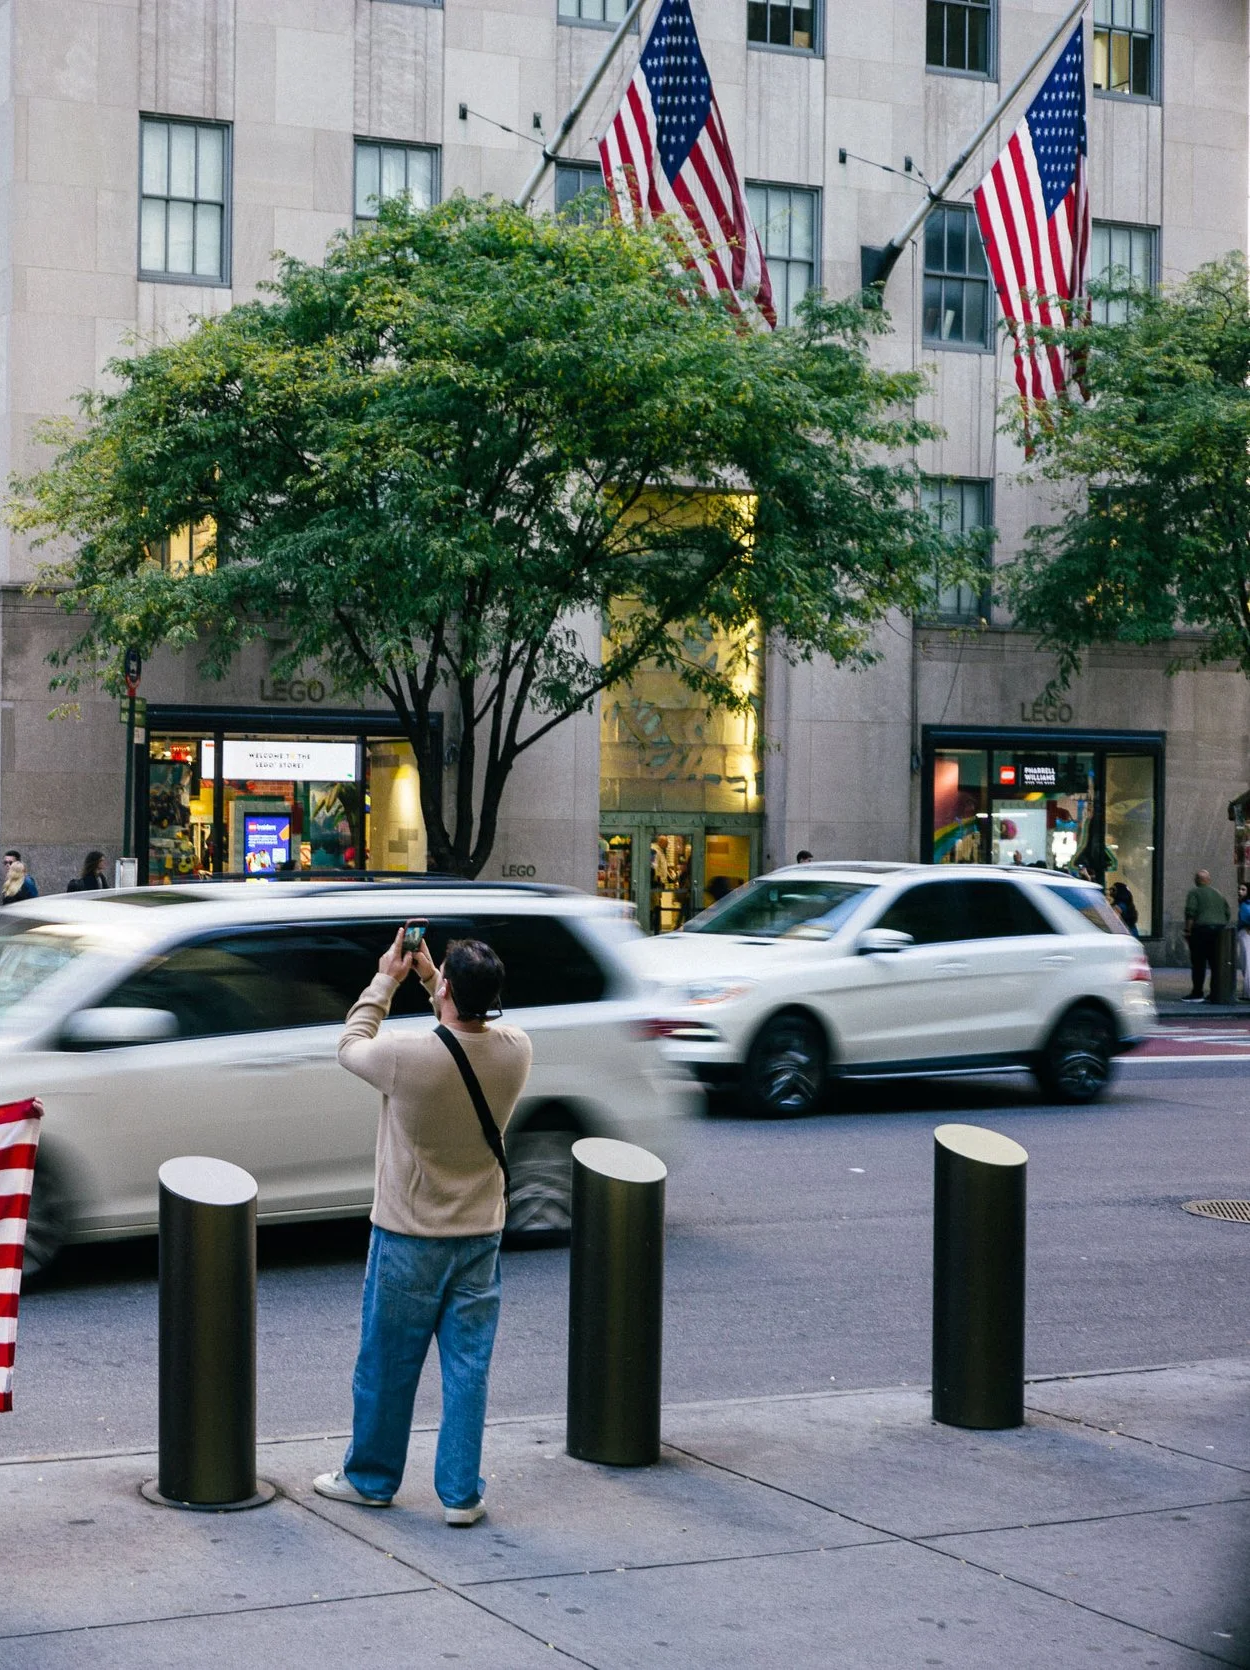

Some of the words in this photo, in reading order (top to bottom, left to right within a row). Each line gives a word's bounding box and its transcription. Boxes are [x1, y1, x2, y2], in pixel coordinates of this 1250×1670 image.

[259, 680, 325, 702] LEGO
[1021, 702, 1073, 723] LEGO
[502, 865, 537, 877] LEGO
